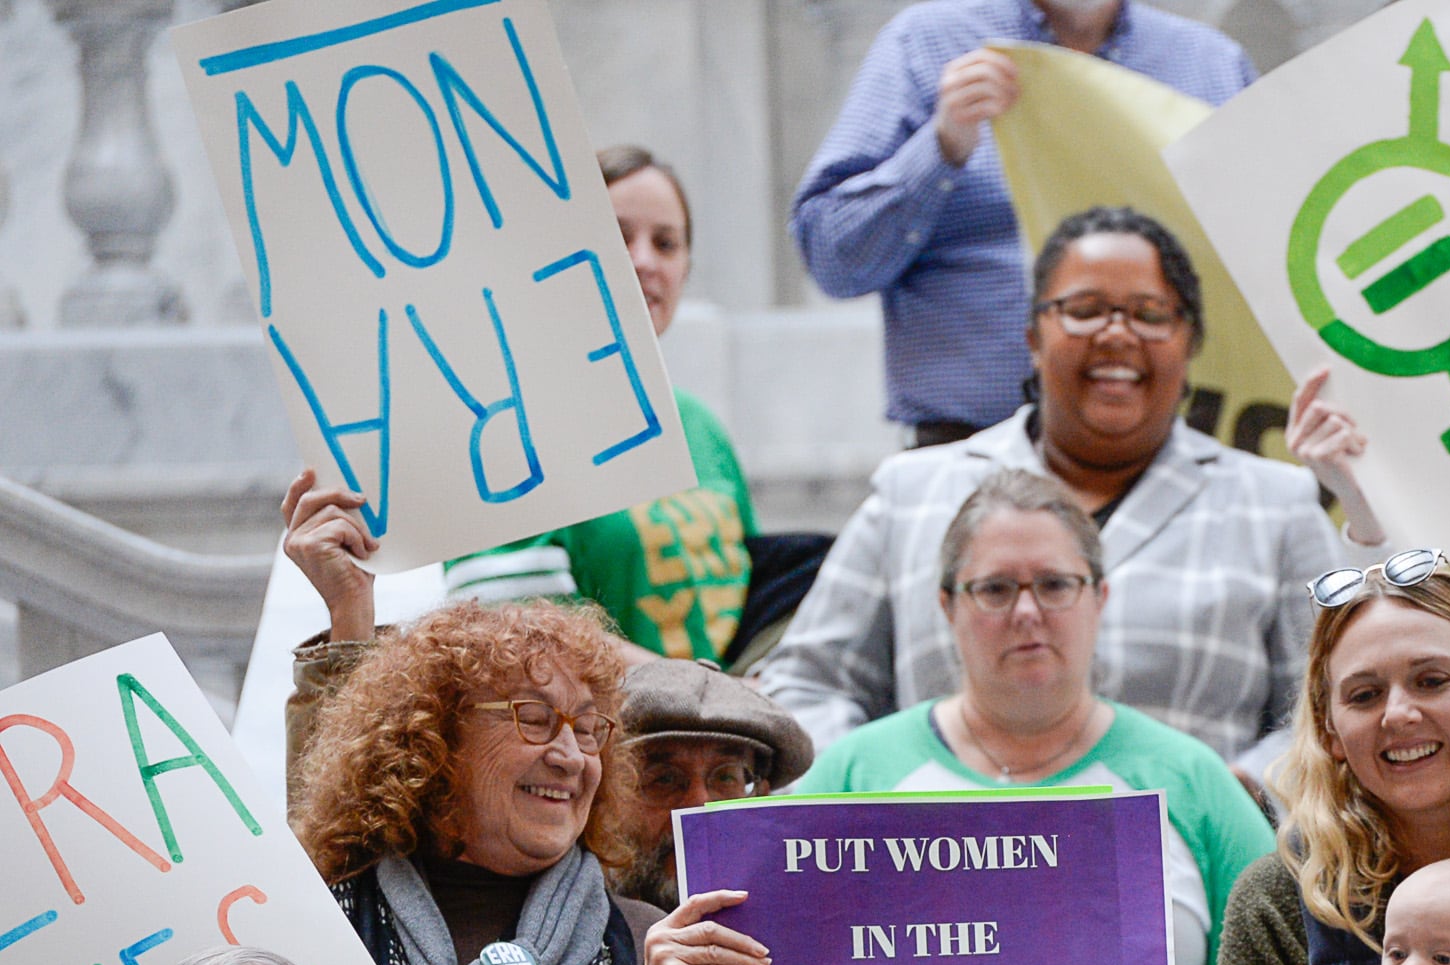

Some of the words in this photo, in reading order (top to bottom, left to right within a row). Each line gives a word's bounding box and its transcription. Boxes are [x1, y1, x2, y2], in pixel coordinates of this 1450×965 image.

[234, 17, 572, 318] NOW
[268, 249, 662, 538] ERA
[0, 672, 262, 906] RA
[783, 836, 876, 874] PUT
[881, 834, 1059, 873] WOMEN
[485, 943, 528, 965] ERA
[850, 924, 896, 960] IN
[906, 921, 1001, 958] THE
